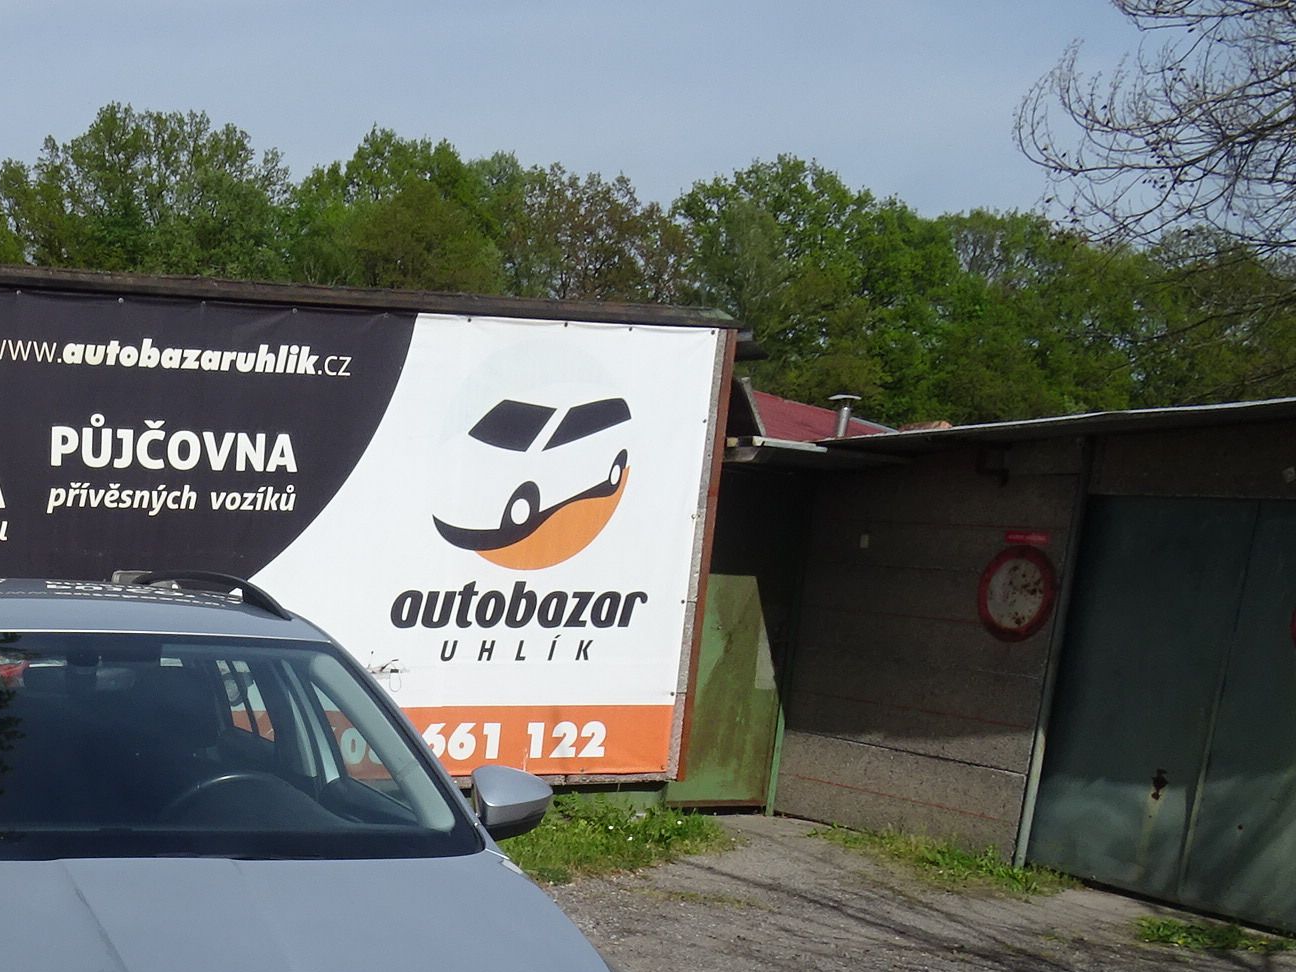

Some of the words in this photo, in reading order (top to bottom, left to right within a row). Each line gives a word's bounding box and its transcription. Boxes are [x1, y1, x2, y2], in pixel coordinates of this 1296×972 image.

[50, 413, 298, 473] PŮJČOVNA
[46, 482, 197, 516] přívěsných
[210, 484, 297, 511] vozíků
[390, 580, 649, 629] autobazar
[440, 635, 594, 661] UHLÍK
[527, 721, 607, 759] 122
